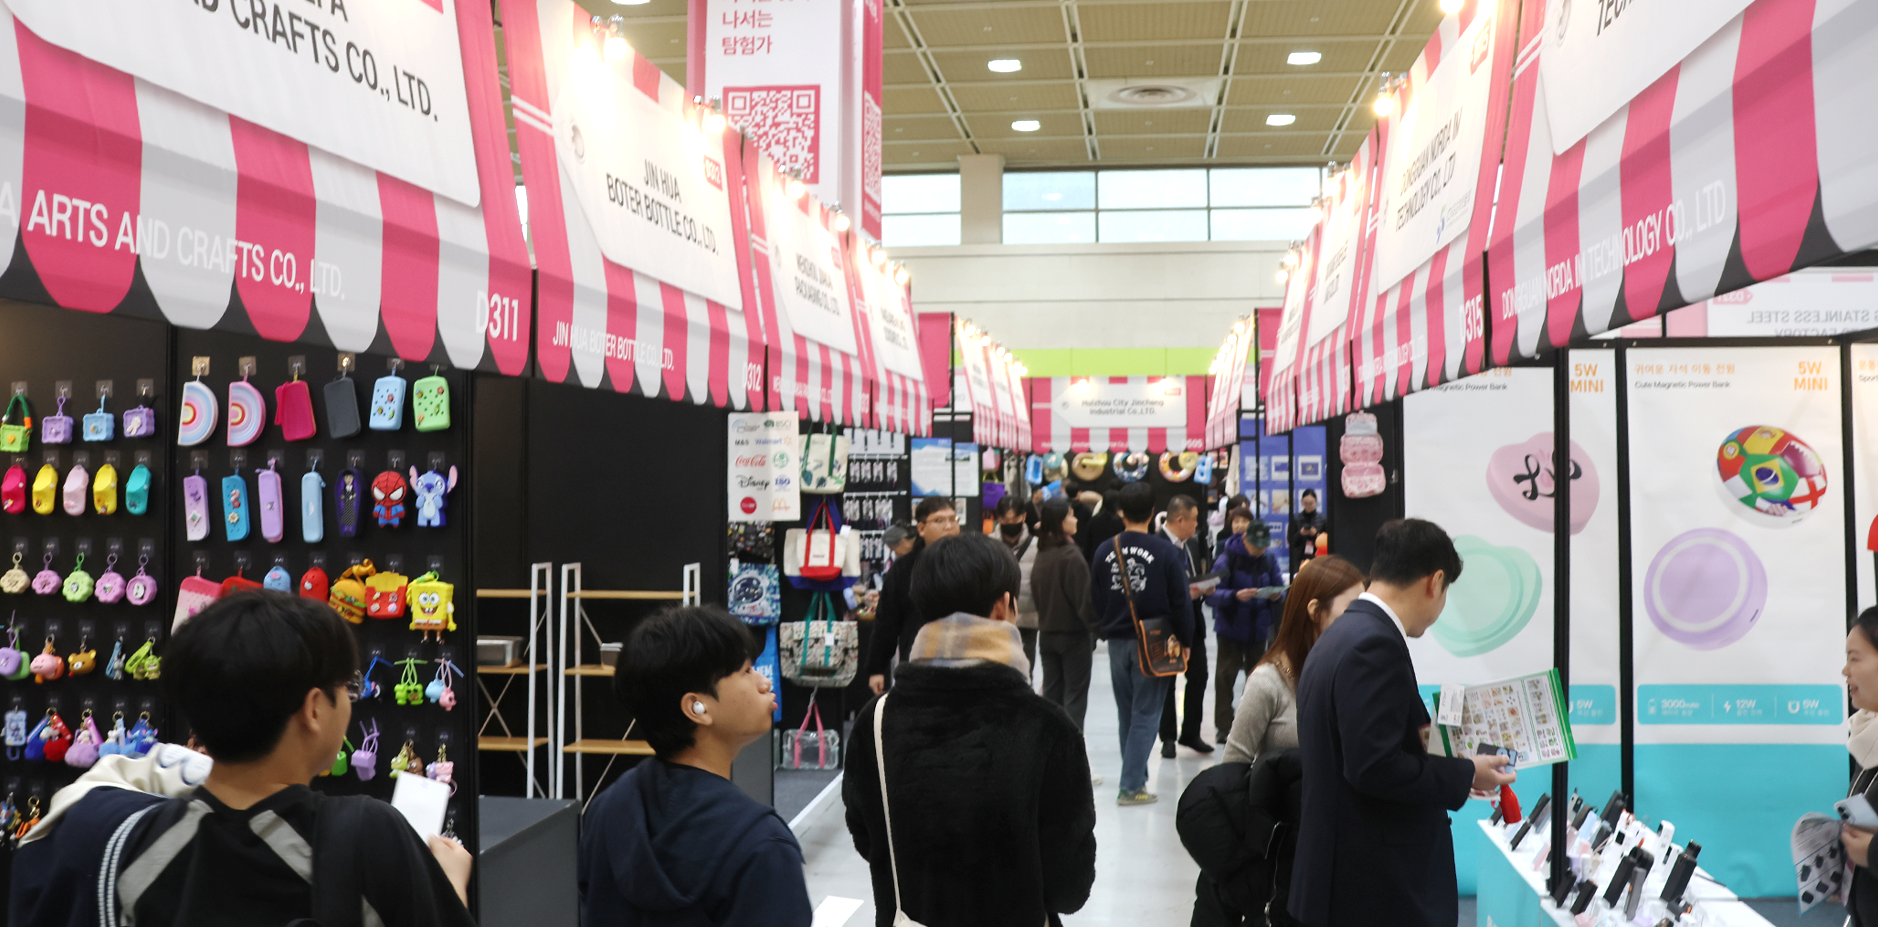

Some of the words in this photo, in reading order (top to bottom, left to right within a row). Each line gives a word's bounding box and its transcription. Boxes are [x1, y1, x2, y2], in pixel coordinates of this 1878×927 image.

[722, 9, 773, 29] 나서는
[722, 35, 773, 55] 탐험가
[231, 0, 340, 73] CRAFTS
[346, 41, 391, 102] CO.,
[393, 65, 438, 122] LTD.
[644, 158, 659, 192] JIN
[659, 168, 682, 204] HUA
[606, 172, 644, 218] BOTER
[644, 193, 682, 237] BOTTLE
[27, 189, 109, 248] ARTS
[114, 211, 170, 260] AND
[176, 226, 265, 283] CRAFTS
[270, 248, 305, 295] CO.,
[309, 258, 346, 301] LTD.
[1502, 275, 1543, 321] DONGGUAN
[1543, 257, 1574, 301] NORDA
[1586, 209, 1664, 282] TECHNOLOGY
[1665, 198, 1693, 247] CO.,
[1695, 178, 1727, 232] LTD
[475, 291, 519, 342] D311
[1459, 293, 1483, 344] D315
[552, 320, 569, 347] JIN
[570, 324, 588, 352] HUA
[589, 330, 617, 358] BOTER
[616, 337, 646, 363] BOTTLE
[742, 362, 762, 392] D312
[1574, 363, 1599, 377] 5W
[1798, 361, 1823, 375] 5W
[1489, 382, 1508, 390] Bank
[1570, 380, 1604, 393] MINI
[1794, 378, 1828, 391] MINI
[1089, 407, 1126, 416] Industrial
[1113, 399, 1129, 407] City
[1105, 546, 1129, 563] TEM
[1129, 546, 1155, 564] WORK
